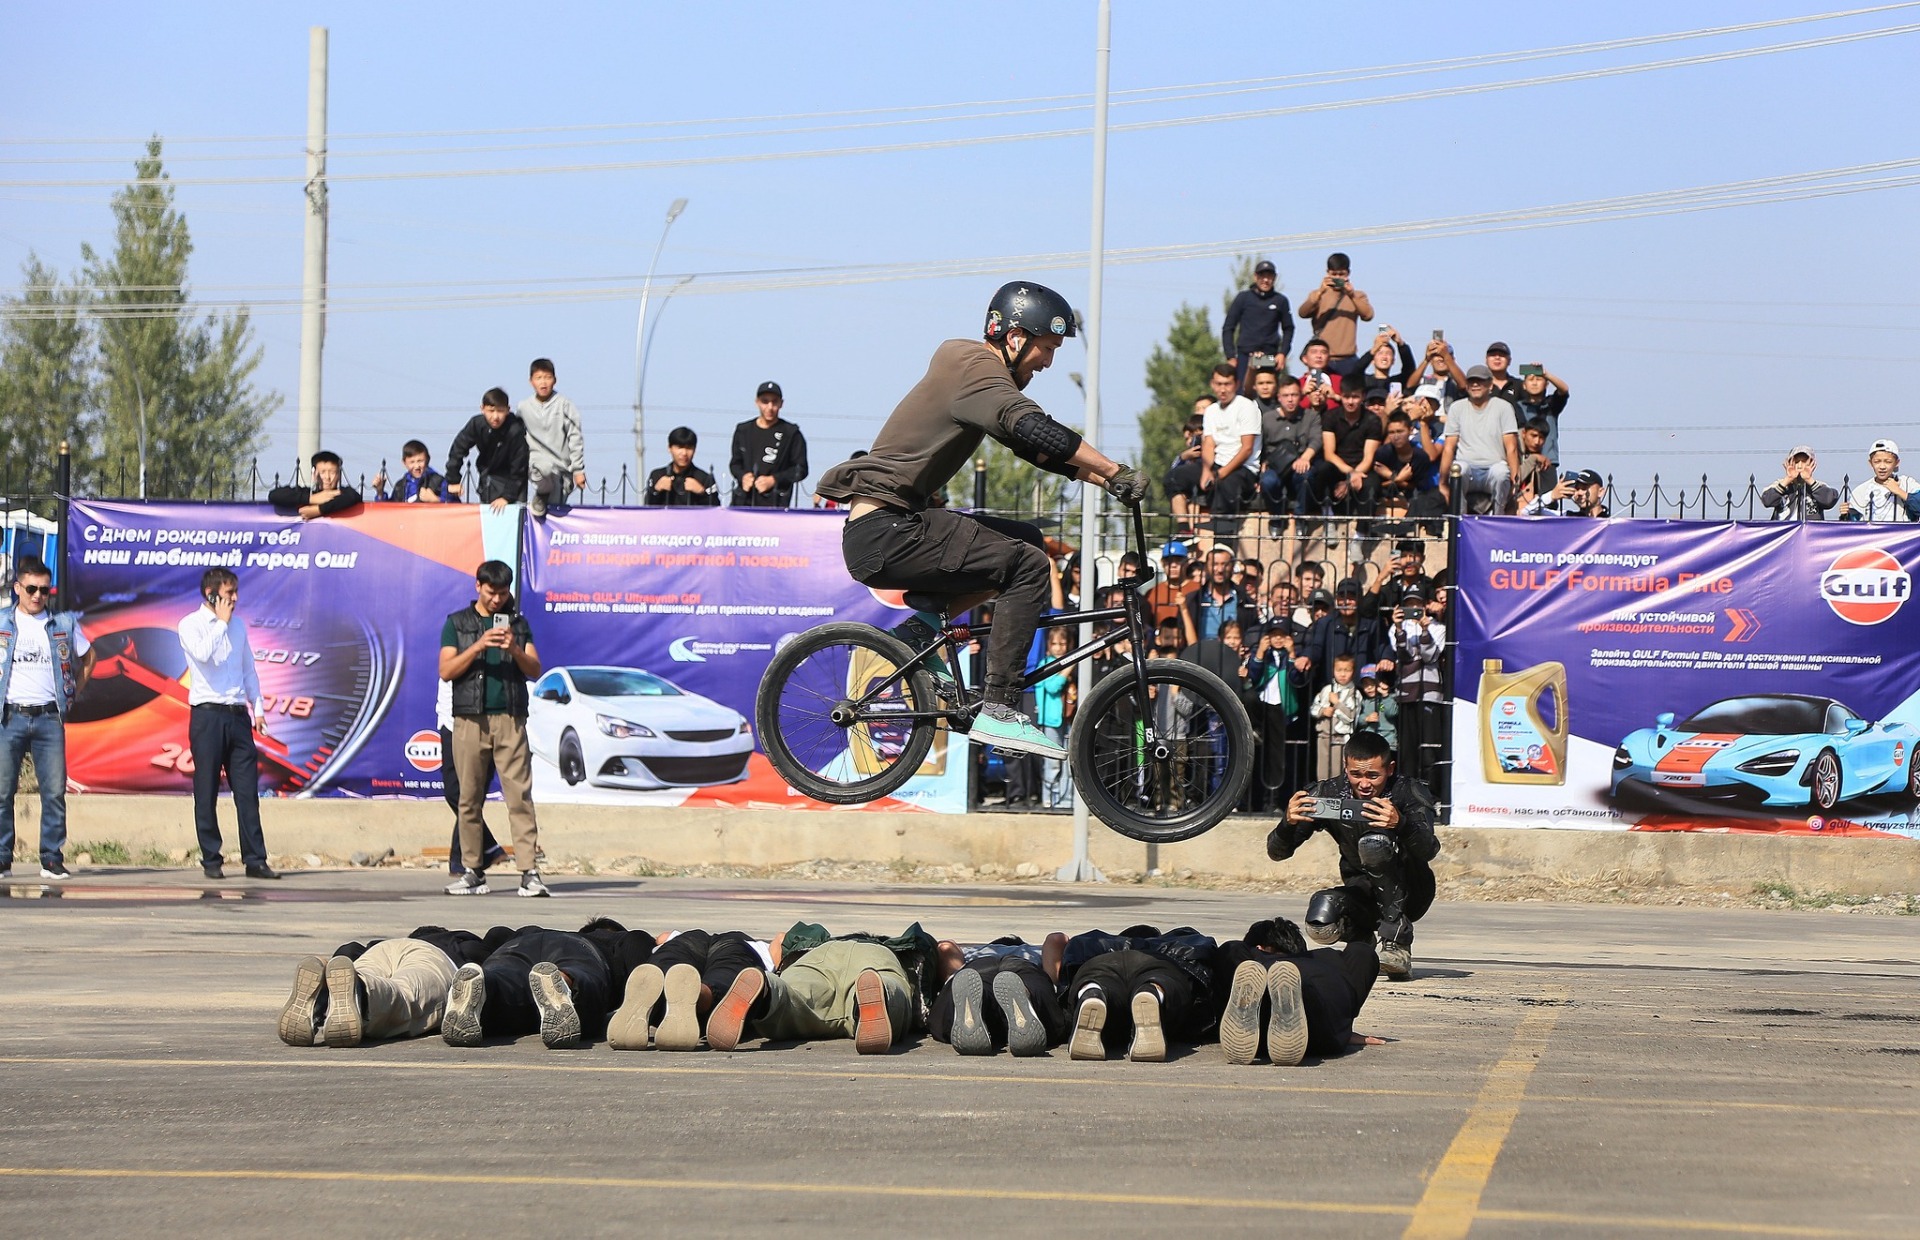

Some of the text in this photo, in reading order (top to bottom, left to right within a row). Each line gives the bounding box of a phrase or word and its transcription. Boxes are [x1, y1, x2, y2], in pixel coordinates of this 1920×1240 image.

[84, 525, 301, 546] С днем рождения тебя
[550, 531, 780, 548] Для защиты каждого двигателя
[84, 548, 358, 570] наш любимый город Ош!
[547, 549, 810, 569] Для каждой приятной поездки
[1490, 549, 1658, 568] McLaren рекомендует
[1490, 568, 1560, 590] GULF
[1568, 570, 1669, 592] Formula
[1823, 574, 1908, 597] Gulf
[546, 590, 590, 603] Залейте
[592, 592, 622, 603] GULF
[545, 602, 834, 617] в двигатель вашей машины для приятного вождения
[1611, 611, 1716, 624] Пик устойчивой
[1577, 622, 1715, 634] производительности
[1591, 648, 1881, 664] Залейте GULF Formula Elite для достижения максимальной
[1590, 659, 1822, 671] производительности двигателя вашей машины
[407, 745, 442, 757] Gul
[1468, 804, 1512, 815] Вместе,
[1537, 808, 1549, 816] не
[1553, 808, 1624, 819] остановить!
